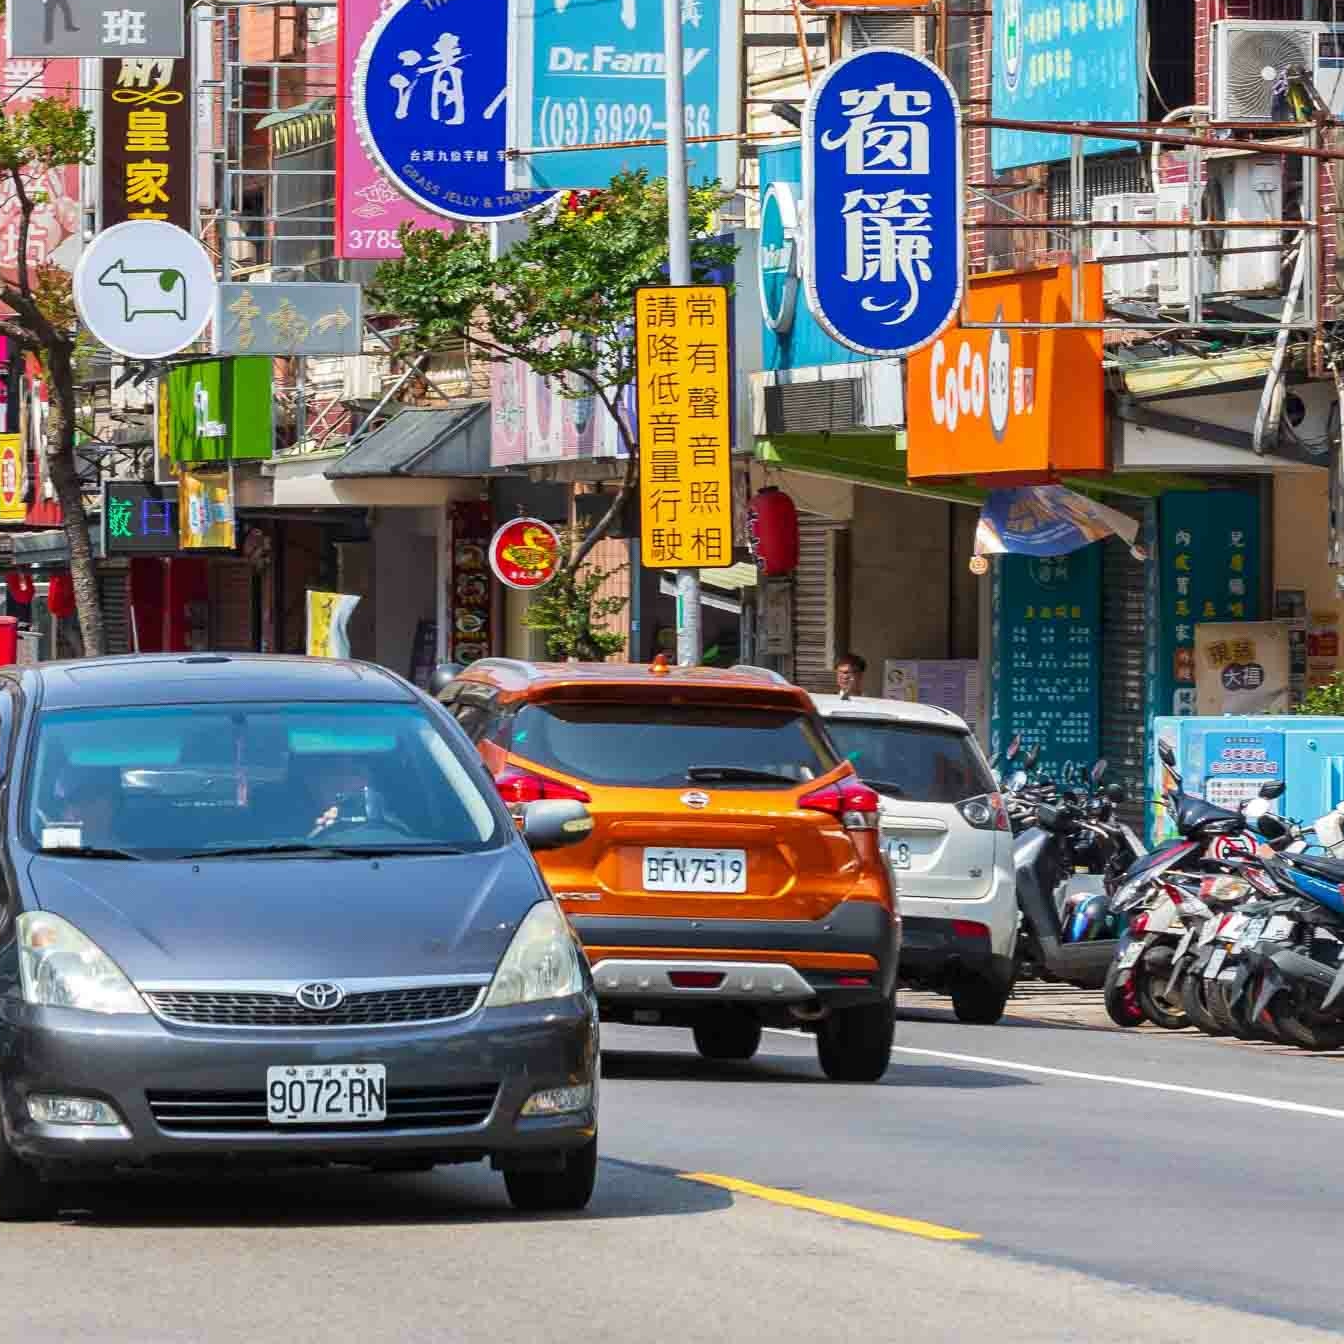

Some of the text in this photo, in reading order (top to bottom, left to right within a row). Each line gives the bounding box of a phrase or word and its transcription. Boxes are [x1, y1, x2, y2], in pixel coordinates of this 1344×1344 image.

[548, 47, 710, 74] Dr.Famy
[124, 108, 172, 220] 皇家
[442, 190, 480, 207] JELLY
[820, 82, 934, 327] 窗簾
[645, 294, 683, 562] 請降低音量行駛
[686, 293, 721, 561] 常有聲音照相
[930, 340, 985, 432] CoCo
[646, 856, 743, 886] BFN-7519
[269, 1077, 385, 1115] 9072-RN
